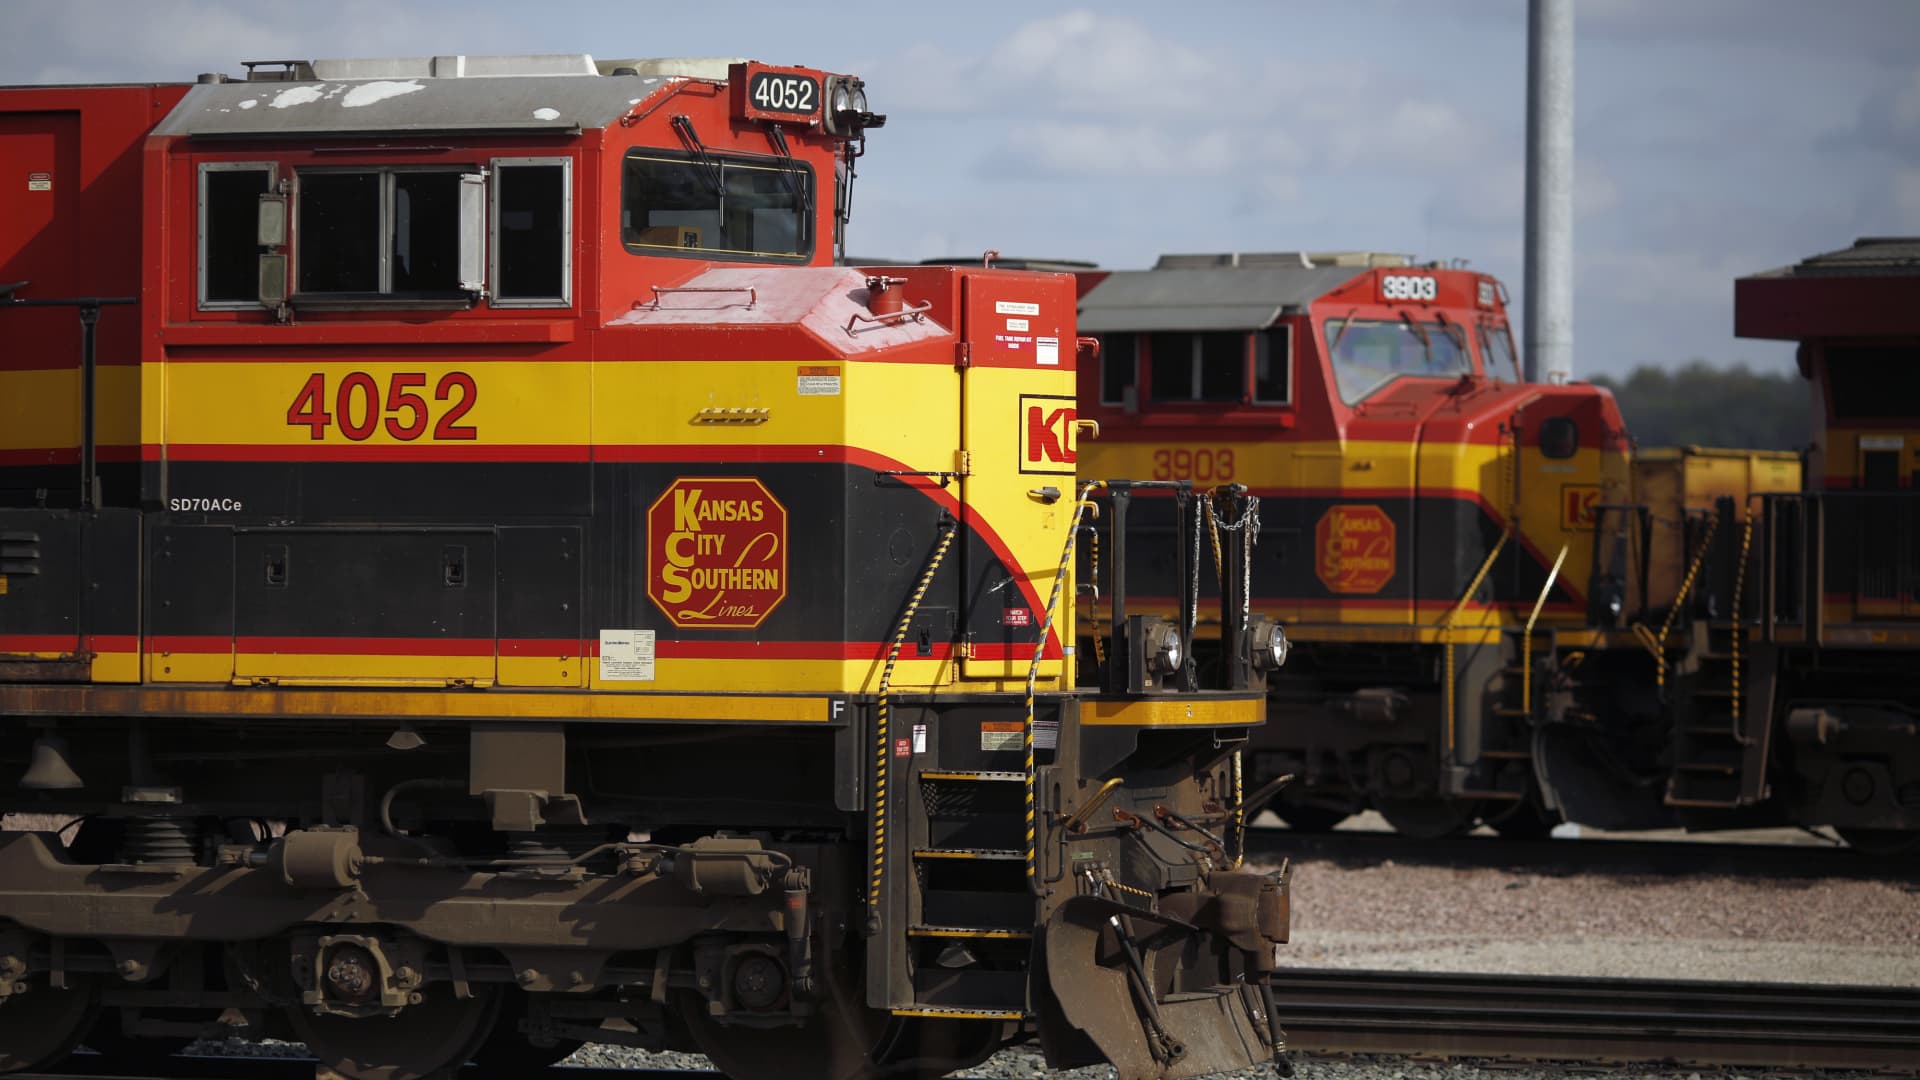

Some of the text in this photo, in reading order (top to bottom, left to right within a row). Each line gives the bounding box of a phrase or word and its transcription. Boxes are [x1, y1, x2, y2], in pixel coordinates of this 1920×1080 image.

[755, 77, 812, 110] 4052
[1383, 276, 1436, 300] 3903
[287, 371, 477, 441] 4052
[1153, 448, 1234, 481] 3903
[170, 498, 242, 511] SD70ACe
[674, 489, 764, 531] KANSAS
[665, 529, 726, 567] CITY
[662, 563, 778, 604] SOUTHERN
[677, 591, 761, 620] Lines
[833, 700, 846, 719] F
